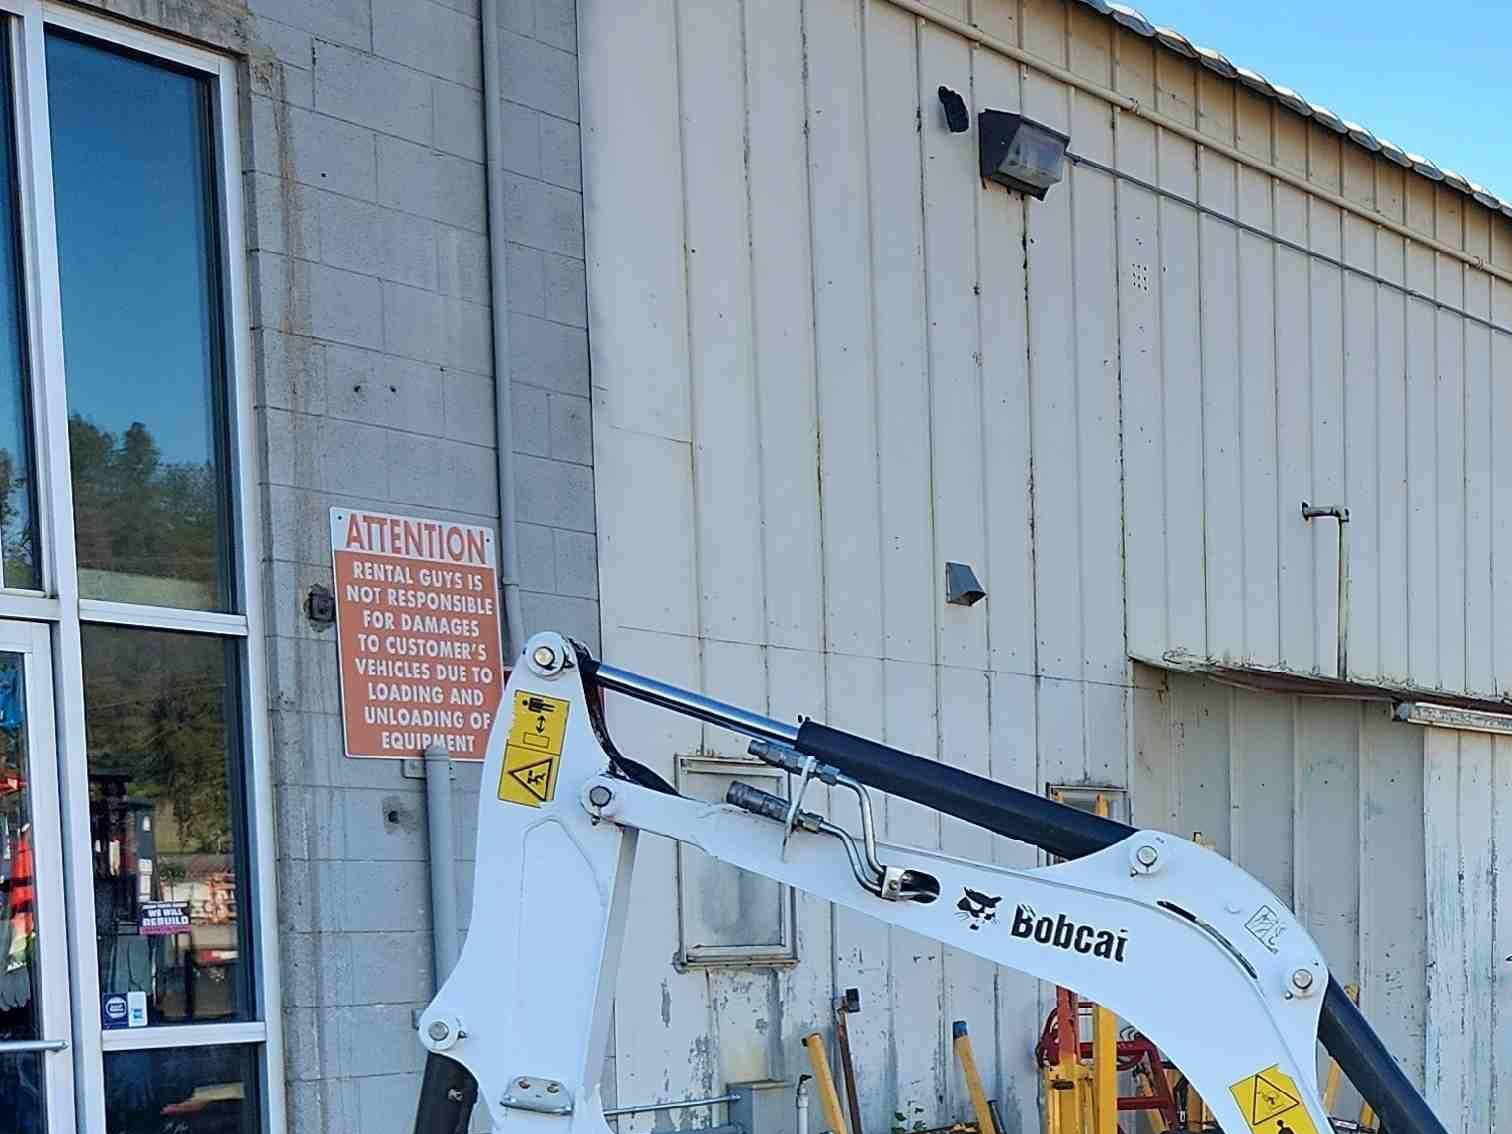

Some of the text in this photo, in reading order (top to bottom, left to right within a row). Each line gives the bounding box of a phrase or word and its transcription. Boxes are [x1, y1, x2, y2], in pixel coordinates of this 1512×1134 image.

[346, 512, 486, 564] ATTENTION
[353, 561, 482, 591] RENTAL GUYS IS
[346, 585, 493, 615] NOT RESPONSIBLE
[363, 610, 480, 637] FOR DAMAGES
[357, 633, 487, 661] TO CUSTOMER'S
[355, 658, 493, 684] VEHICLES DUE TO
[368, 682, 484, 706] LOADING AND
[364, 706, 491, 730] UNLOADING OF
[382, 731, 476, 753] EQUIPMENT
[1011, 904, 1128, 962] Bobcat
